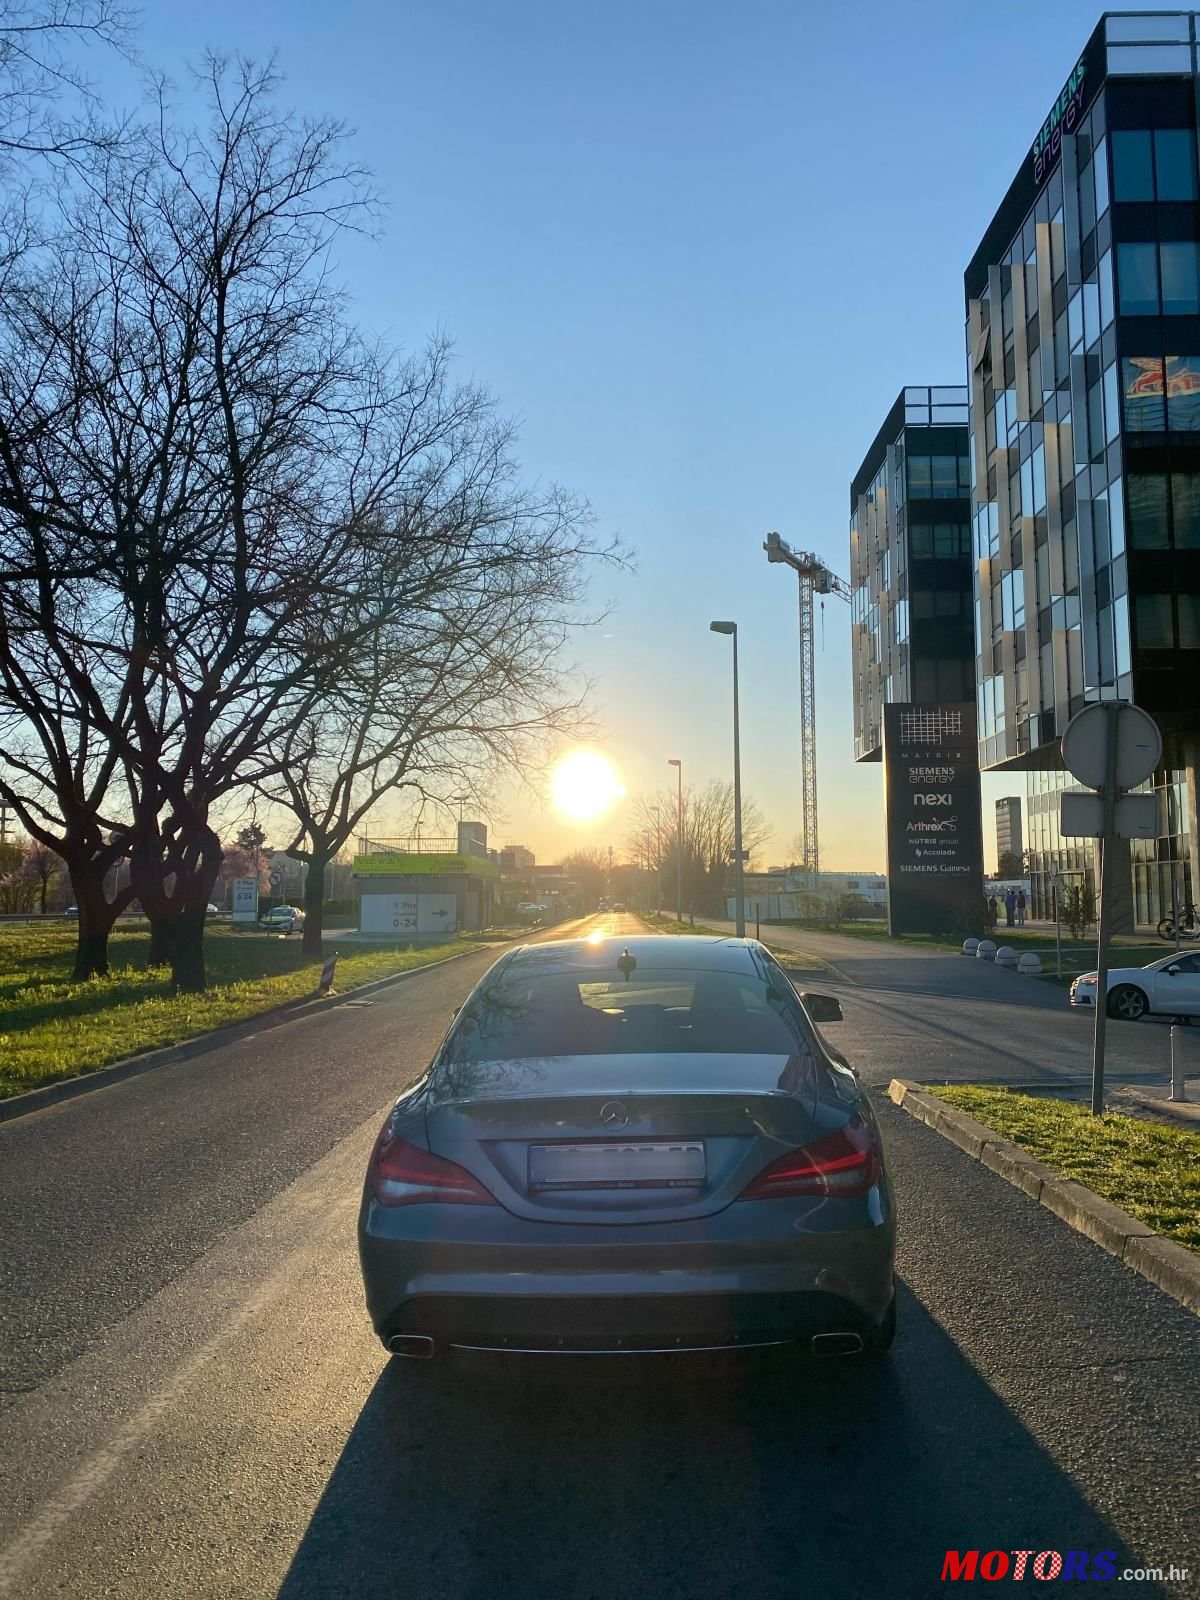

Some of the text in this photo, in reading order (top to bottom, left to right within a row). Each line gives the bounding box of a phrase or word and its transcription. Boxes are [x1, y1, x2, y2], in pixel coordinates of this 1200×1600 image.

[1033, 58, 1086, 163] SIEMENS
[908, 767, 955, 775] SIEMENS
[913, 793, 952, 806] nexi
[906, 821, 943, 832] Arthrex
[940, 864, 971, 872] Gamesa
